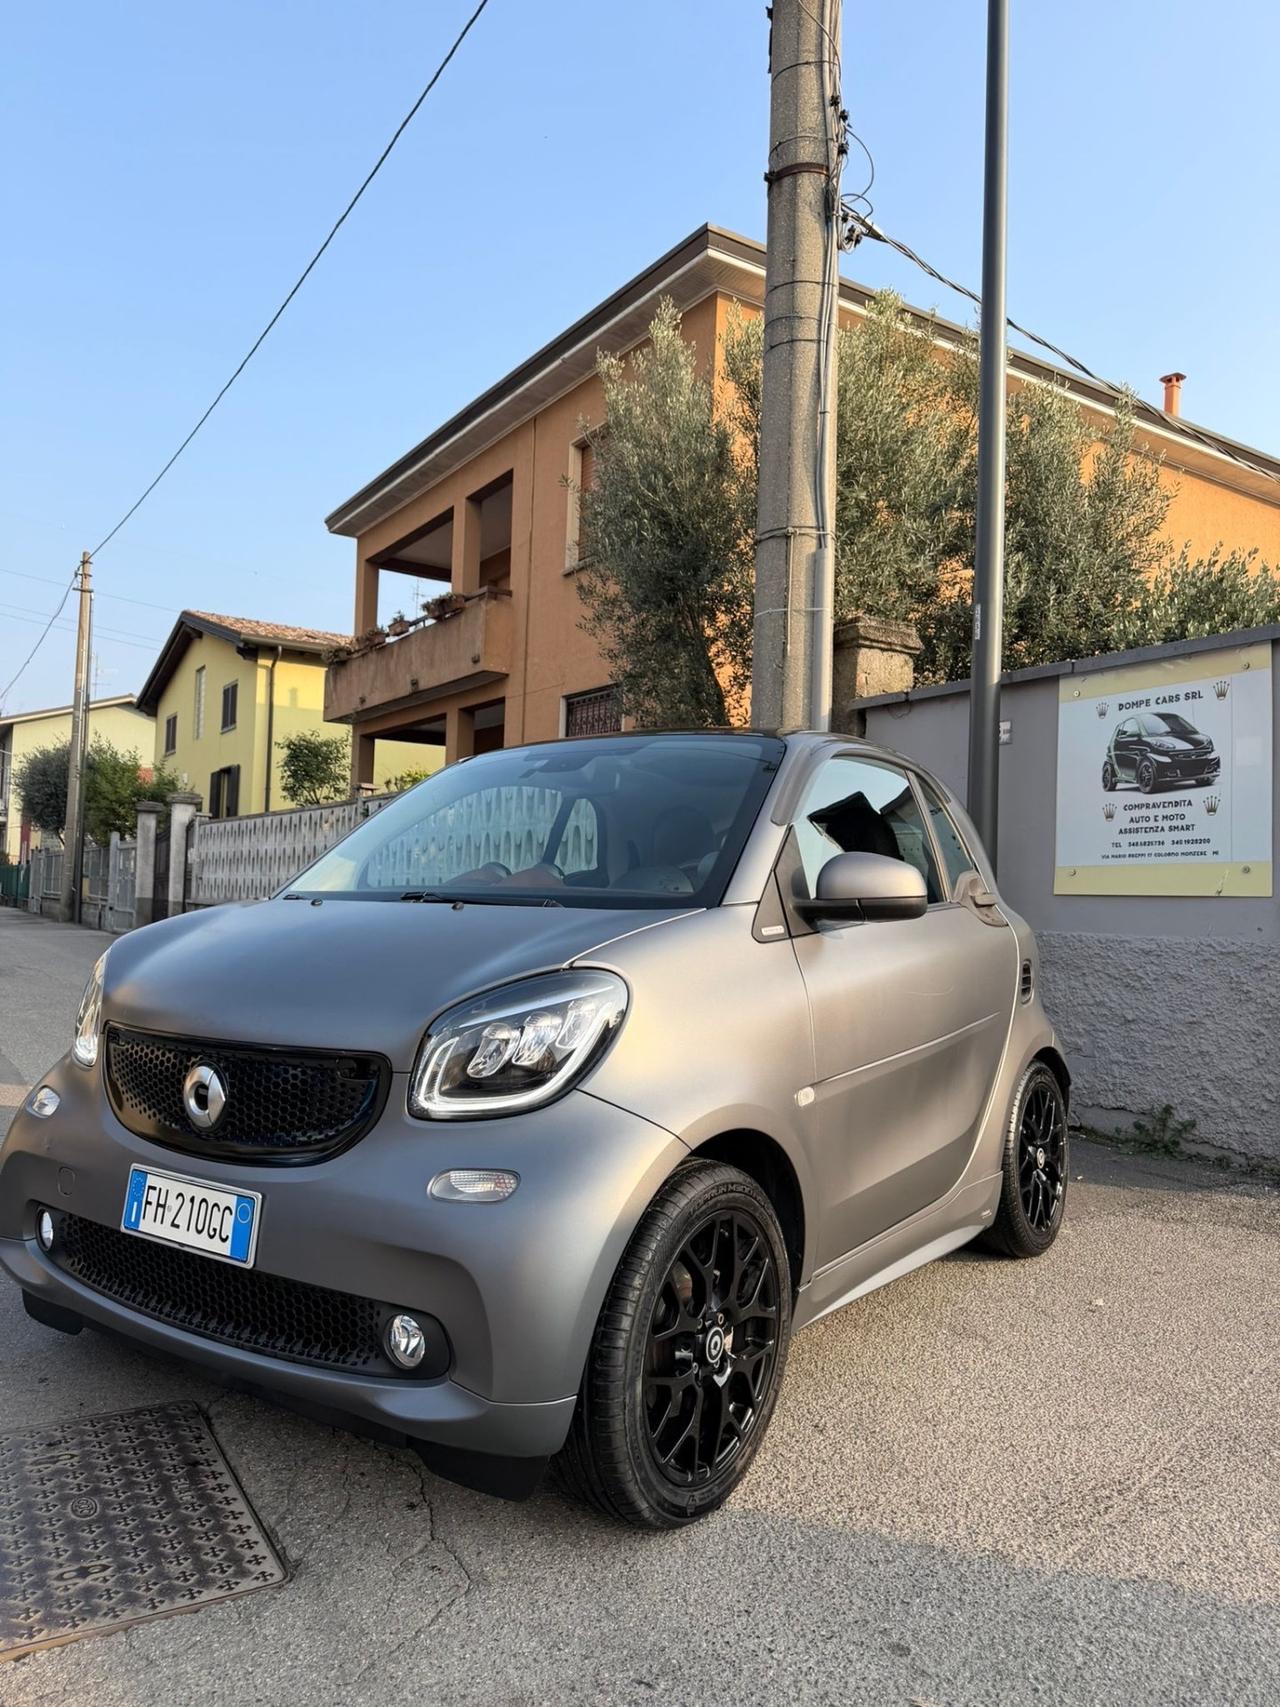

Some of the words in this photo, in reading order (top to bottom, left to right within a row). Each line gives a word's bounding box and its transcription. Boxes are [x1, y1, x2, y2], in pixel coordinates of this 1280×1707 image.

[1118, 699, 1151, 712] DOMPE
[1155, 694, 1181, 706] CARS
[1184, 690, 1204, 701] SRL
[1123, 799, 1193, 811] COMPRAVENDITA
[1129, 814, 1151, 824] AUTO
[1154, 814, 1159, 822] E
[1162, 813, 1186, 822] MOTO
[1118, 825, 1165, 835] ASSISTENZA
[1168, 824, 1195, 833] SMART
